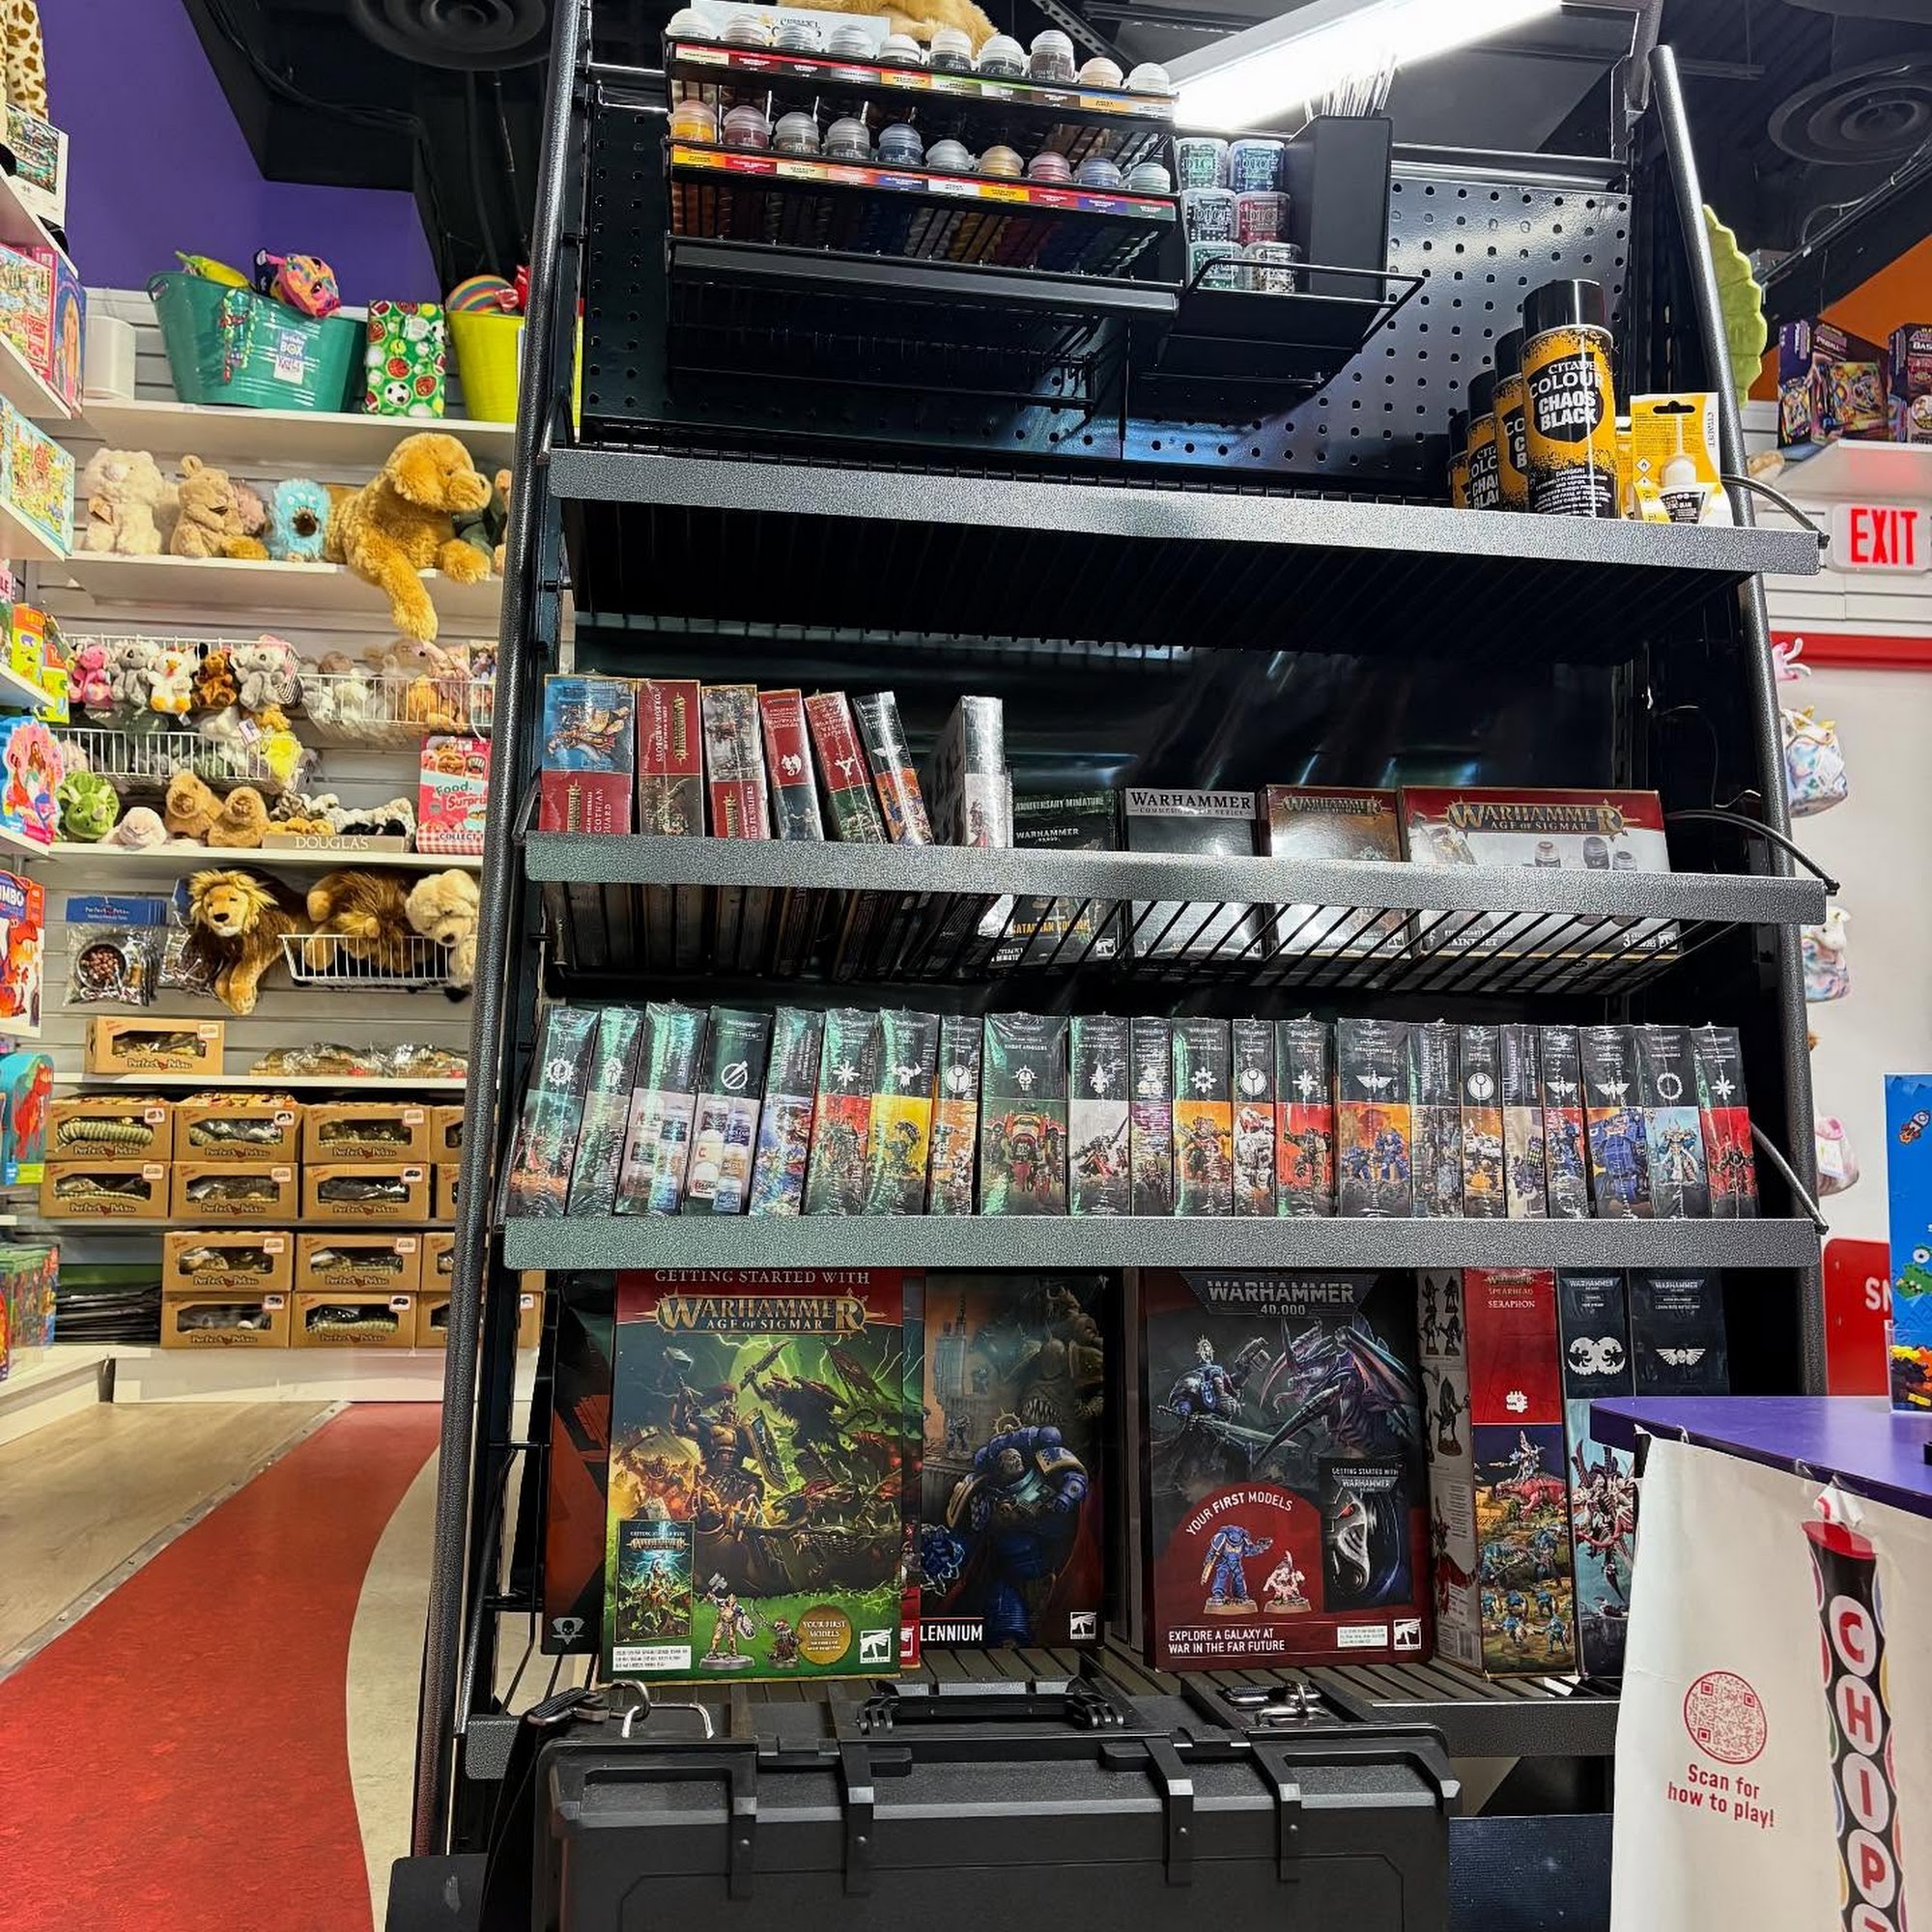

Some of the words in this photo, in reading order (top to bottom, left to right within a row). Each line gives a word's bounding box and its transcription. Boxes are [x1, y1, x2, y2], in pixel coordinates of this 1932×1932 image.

[280, 340, 305, 356] BOX
[1529, 372, 1603, 399] COLOUR
[1538, 390, 1597, 415] CHAOS
[1541, 408, 1597, 432] BLACK
[1850, 508, 1918, 565] EXIT
[1015, 798, 1065, 811] ANNIVERSARY
[1065, 796, 1104, 809] MINIATURE
[1130, 792, 1251, 810] WARHAMMER
[1284, 796, 1382, 815] WARHAMMER
[1449, 803, 1623, 834] WARHAMMER
[1492, 821, 1516, 831] AGE
[1535, 821, 1587, 832] SIGMAR
[1016, 828, 1079, 839] WARHAMMER
[295, 837, 368, 849] DOUGLAS
[655, 1269, 733, 1283] GETTING
[739, 1270, 815, 1284] STARTED
[822, 1271, 870, 1284] WITH
[1208, 1280, 1354, 1303] WARHAMMER
[661, 1296, 866, 1330] WARHAMMER
[1261, 1304, 1305, 1316] 40,000
[706, 1321, 737, 1330] AGE
[760, 1320, 823, 1330] SIGMAR
[1332, 1467, 1356, 1476] GETTING
[1343, 1478, 1391, 1488] WARHAMMER
[1185, 1508, 1214, 1536] YOUR
[1212, 1492, 1244, 1513] FIRST
[1248, 1492, 1293, 1511] MODELS
[803, 1620, 824, 1629] YOUR
[825, 1620, 845, 1629] FIRST
[920, 1624, 983, 1642] LENNIUM
[1169, 1630, 1212, 1641] EXPLORE
[1214, 1630, 1222, 1640] A
[1224, 1629, 1262, 1640] GALAXY
[1264, 1628, 1273, 1639] AT
[1169, 1643, 1191, 1654] WAR
[1193, 1643, 1203, 1653] IN
[1205, 1642, 1225, 1653] THE
[1227, 1641, 1246, 1652] FAR
[1248, 1640, 1285, 1652] FUTURE
[1688, 1764, 1729, 1791] Scan
[1736, 1776, 1760, 1800] for
[1667, 1781, 1703, 1806] how
[1709, 1793, 1727, 1813] to
[1734, 1802, 1774, 1829] play!
